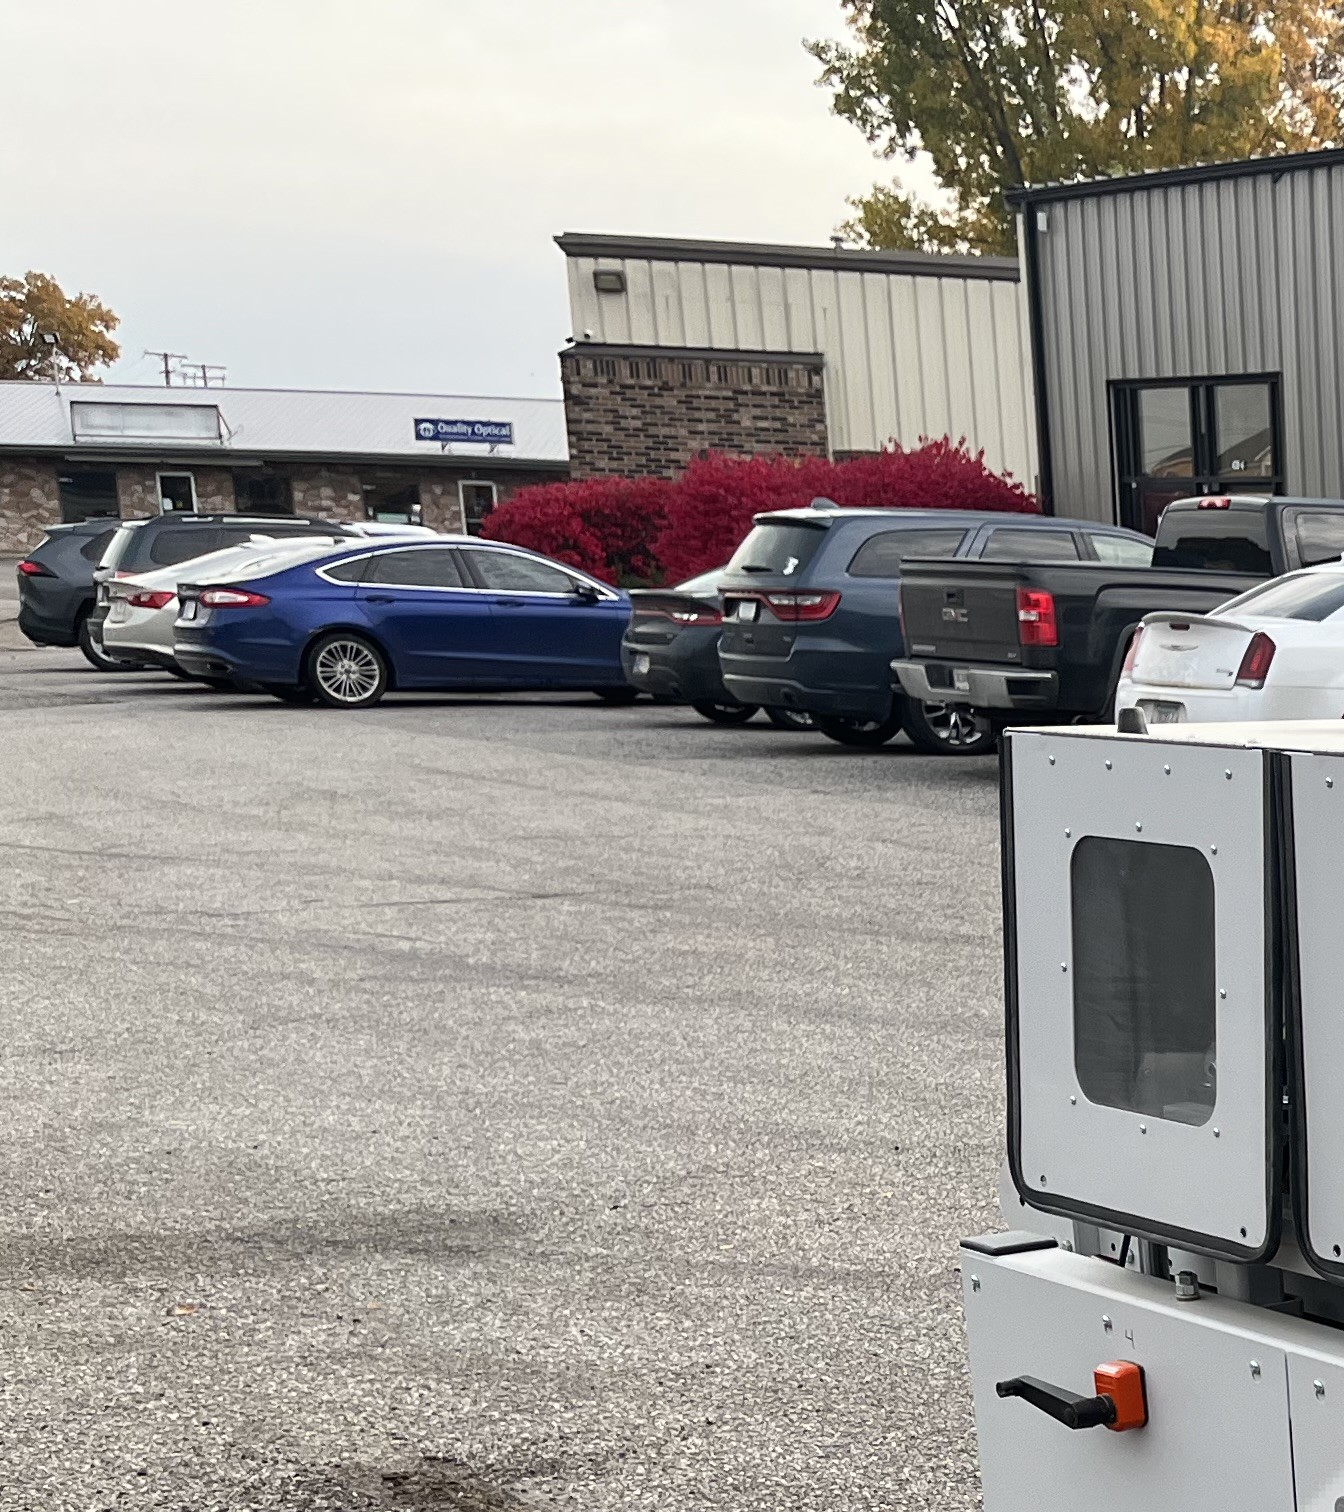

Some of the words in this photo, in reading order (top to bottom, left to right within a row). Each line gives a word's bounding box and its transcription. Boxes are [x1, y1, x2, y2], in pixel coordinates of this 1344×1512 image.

[437, 422, 472, 436] Quality
[474, 423, 510, 438] Optical
[1124, 1329, 1135, 1350] 4
